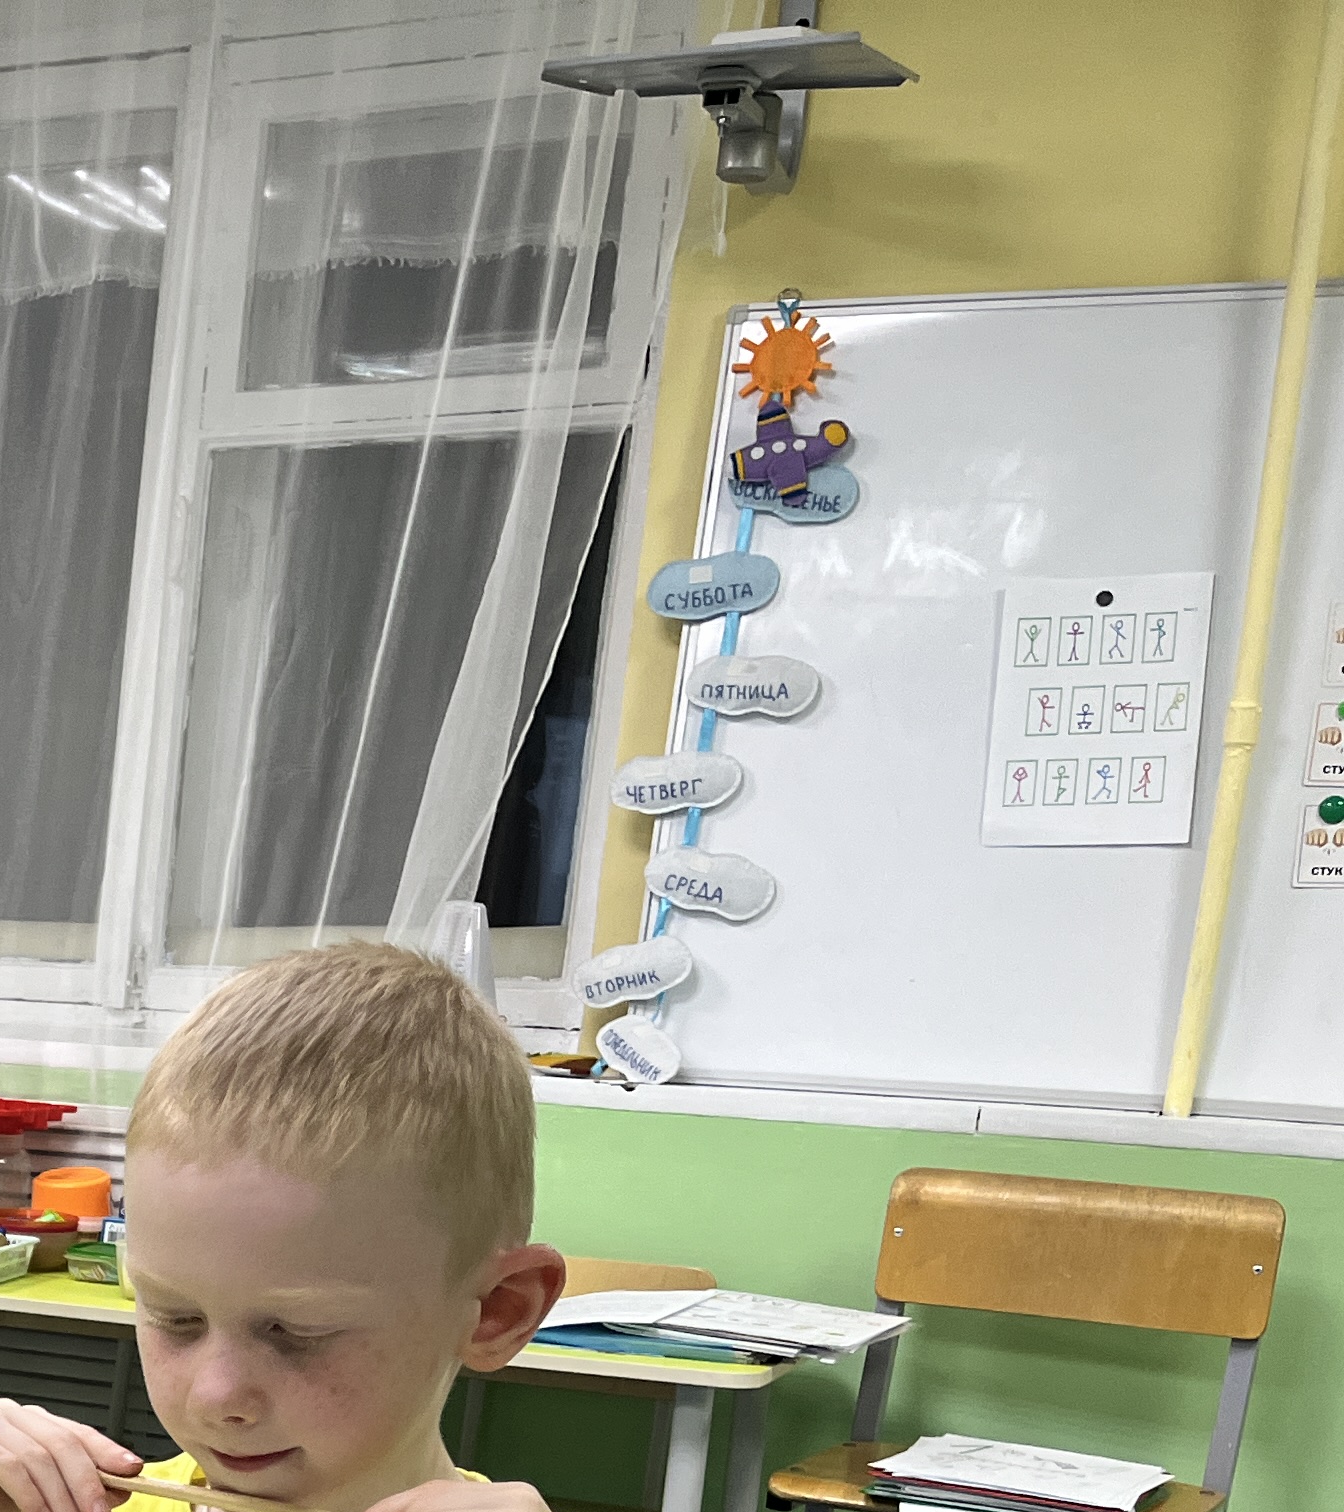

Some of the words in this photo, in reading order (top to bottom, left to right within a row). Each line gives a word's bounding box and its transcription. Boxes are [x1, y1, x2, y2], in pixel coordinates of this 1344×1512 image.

[664, 582, 754, 611] СУББОТА
[700, 682, 789, 702] ПЯТНИЦА
[625, 778, 703, 804] ЧЕТВЕРГ
[664, 874, 724, 904] СРЕДА
[584, 970, 661, 999] ВТОРНИК
